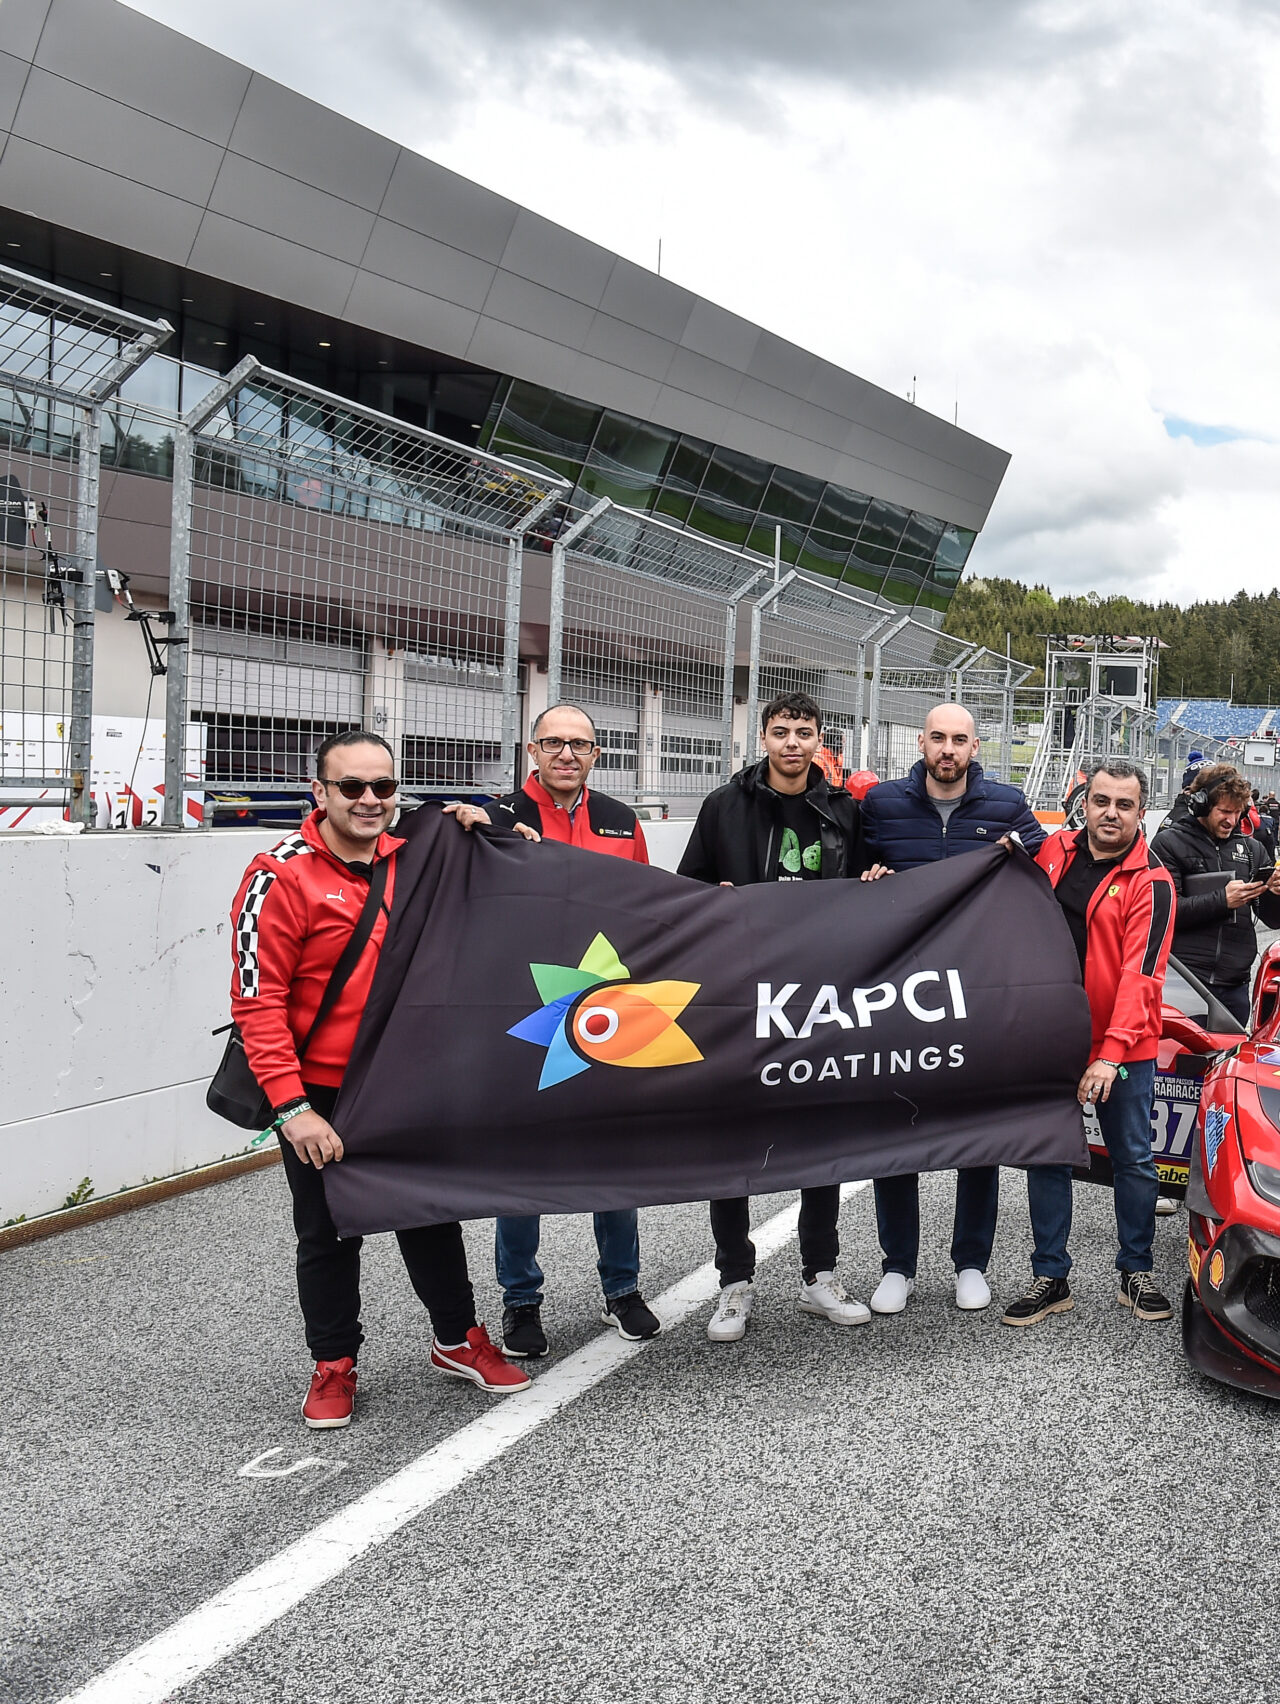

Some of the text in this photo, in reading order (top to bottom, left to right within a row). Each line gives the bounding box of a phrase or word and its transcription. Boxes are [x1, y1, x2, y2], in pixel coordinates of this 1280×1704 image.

[755, 968, 968, 1039] KAPCI
[760, 1044, 965, 1086] COATINGS
[1151, 1100, 1198, 1155] 37
